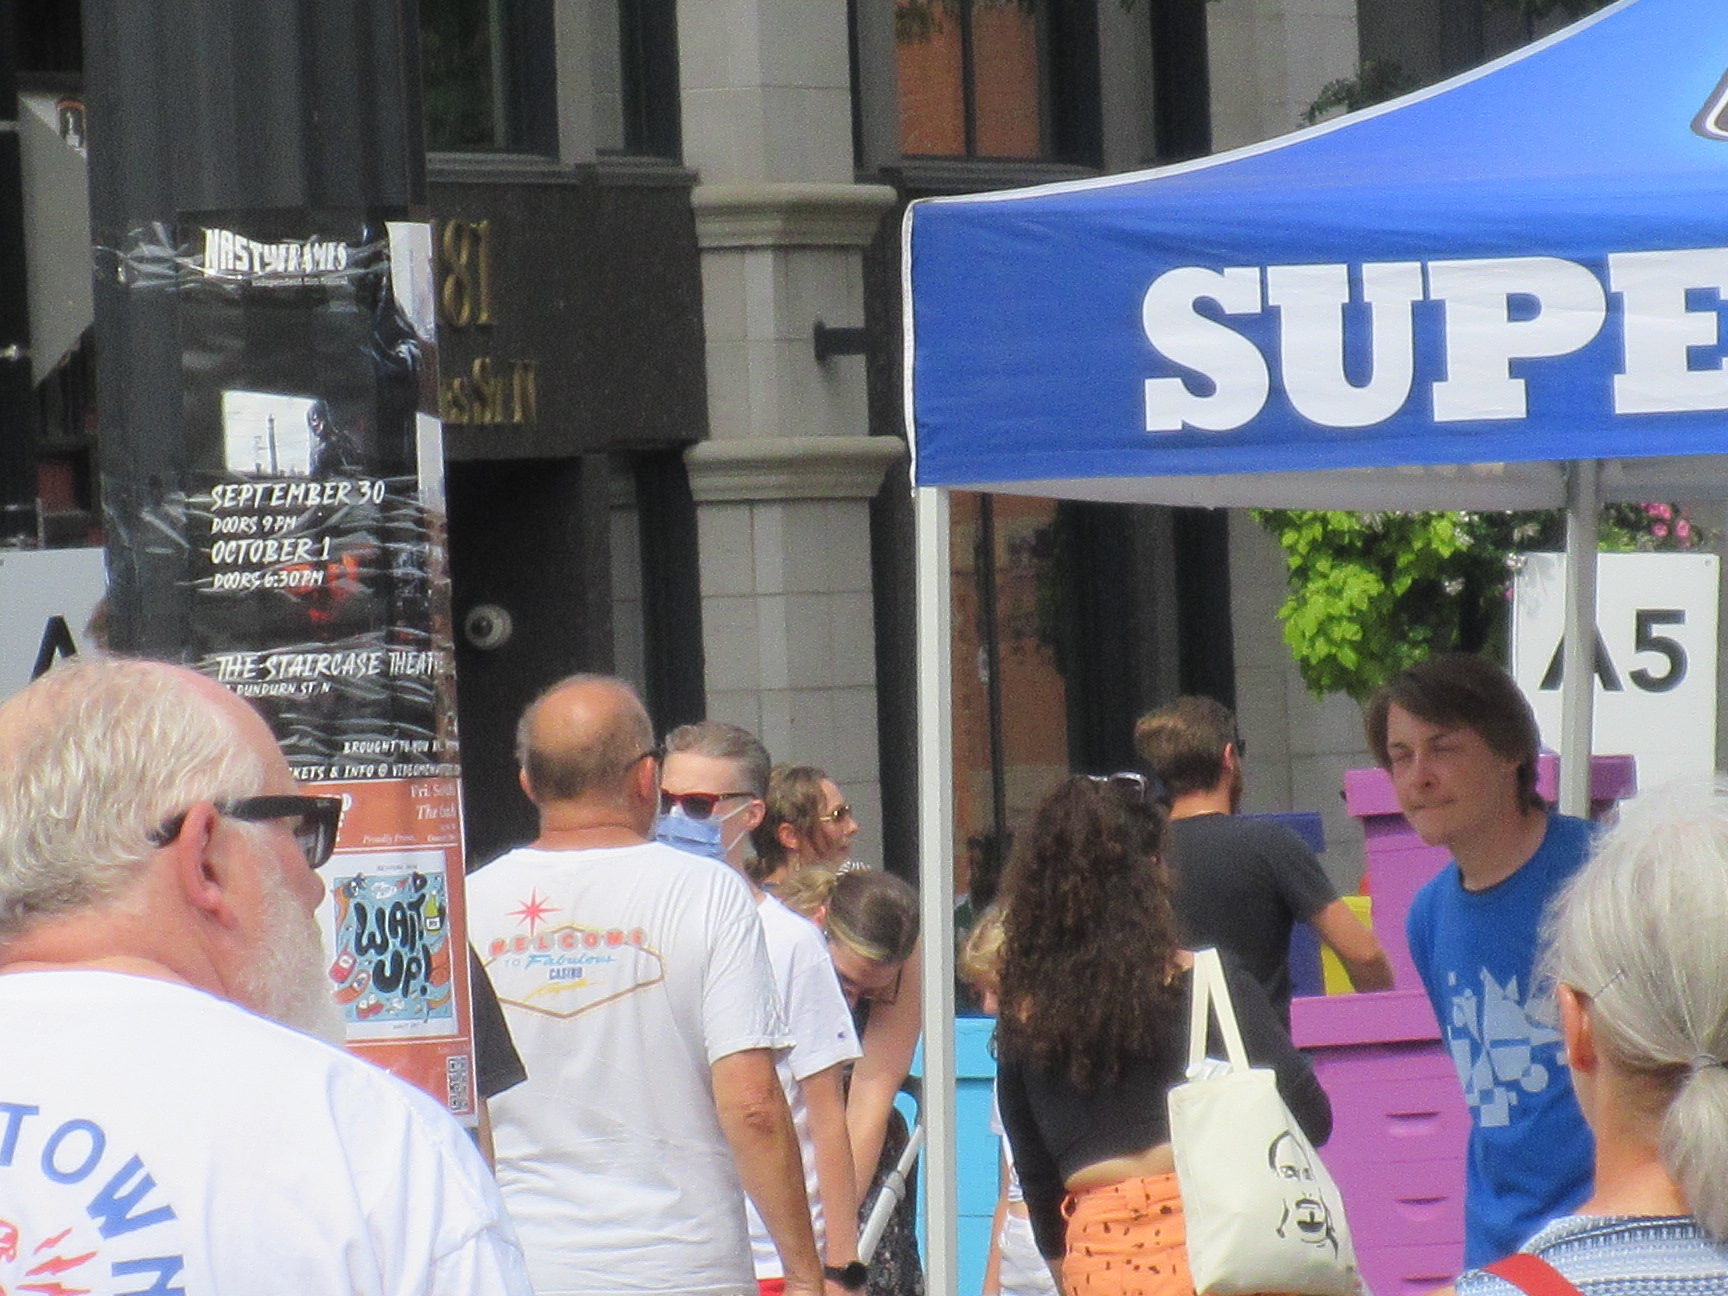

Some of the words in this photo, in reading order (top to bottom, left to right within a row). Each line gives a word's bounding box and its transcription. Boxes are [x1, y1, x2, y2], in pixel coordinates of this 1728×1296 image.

[443, 219, 496, 327] 81
[211, 482, 352, 511] SEPTEMBER
[358, 480, 386, 505] 30
[211, 515, 257, 535] DOORS
[211, 537, 315, 565] OCTOBER
[321, 536, 331, 561] 1
[213, 571, 262, 589] DOORS
[215, 655, 258, 682] THE
[262, 652, 382, 678] STAIRCASE
[236, 683, 297, 697] DUNDURN
[343, 740, 396, 755] BROUGHT
[343, 764, 373, 779] INFO
[490, 928, 645, 956] WELCOME
[372, 943, 432, 999] UP!
[525, 953, 616, 970] Fabulous
[549, 967, 583, 980] CASINO
